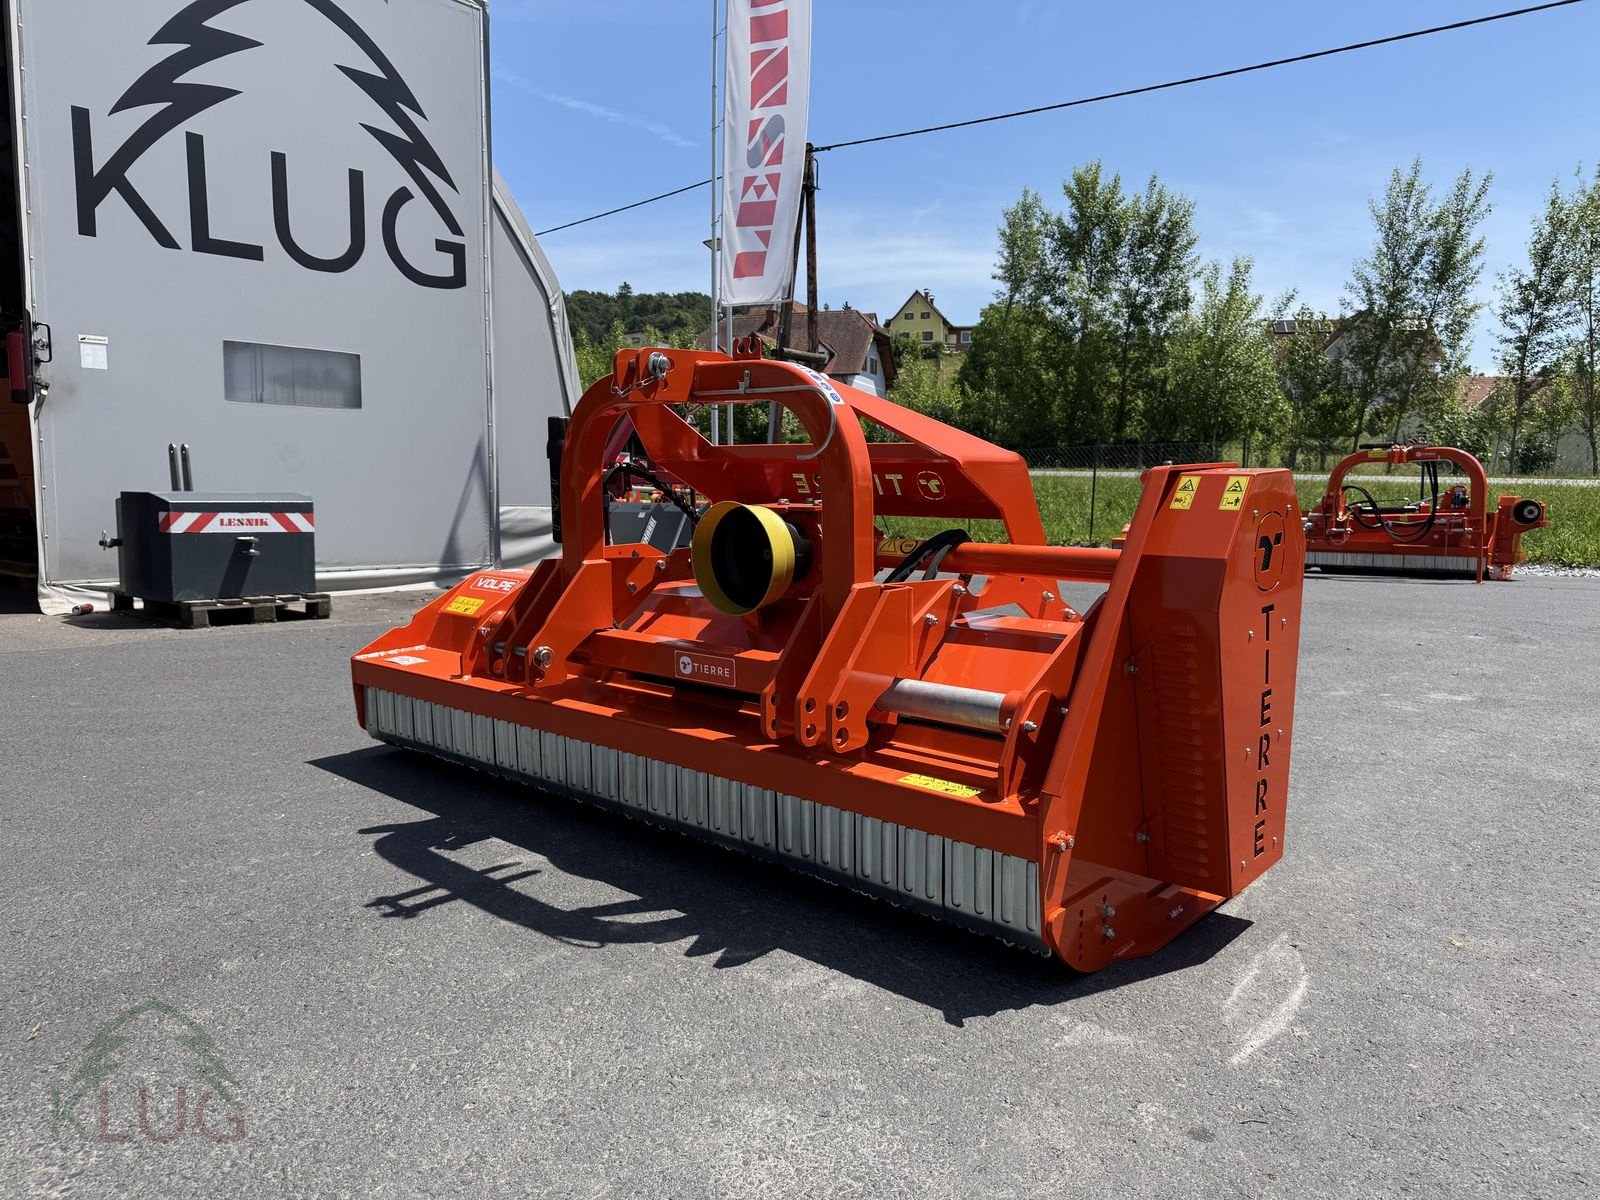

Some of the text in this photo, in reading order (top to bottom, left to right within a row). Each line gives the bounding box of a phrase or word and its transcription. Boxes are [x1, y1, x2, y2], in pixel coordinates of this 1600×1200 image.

[733, 0, 788, 279] LESNI
[71, 104, 467, 290] KLUG
[219, 518, 269, 527] LESNIK
[478, 577, 516, 591] VOLPE
[693, 662, 731, 678] TIERRE
[1253, 603, 1275, 860] TIERRE
